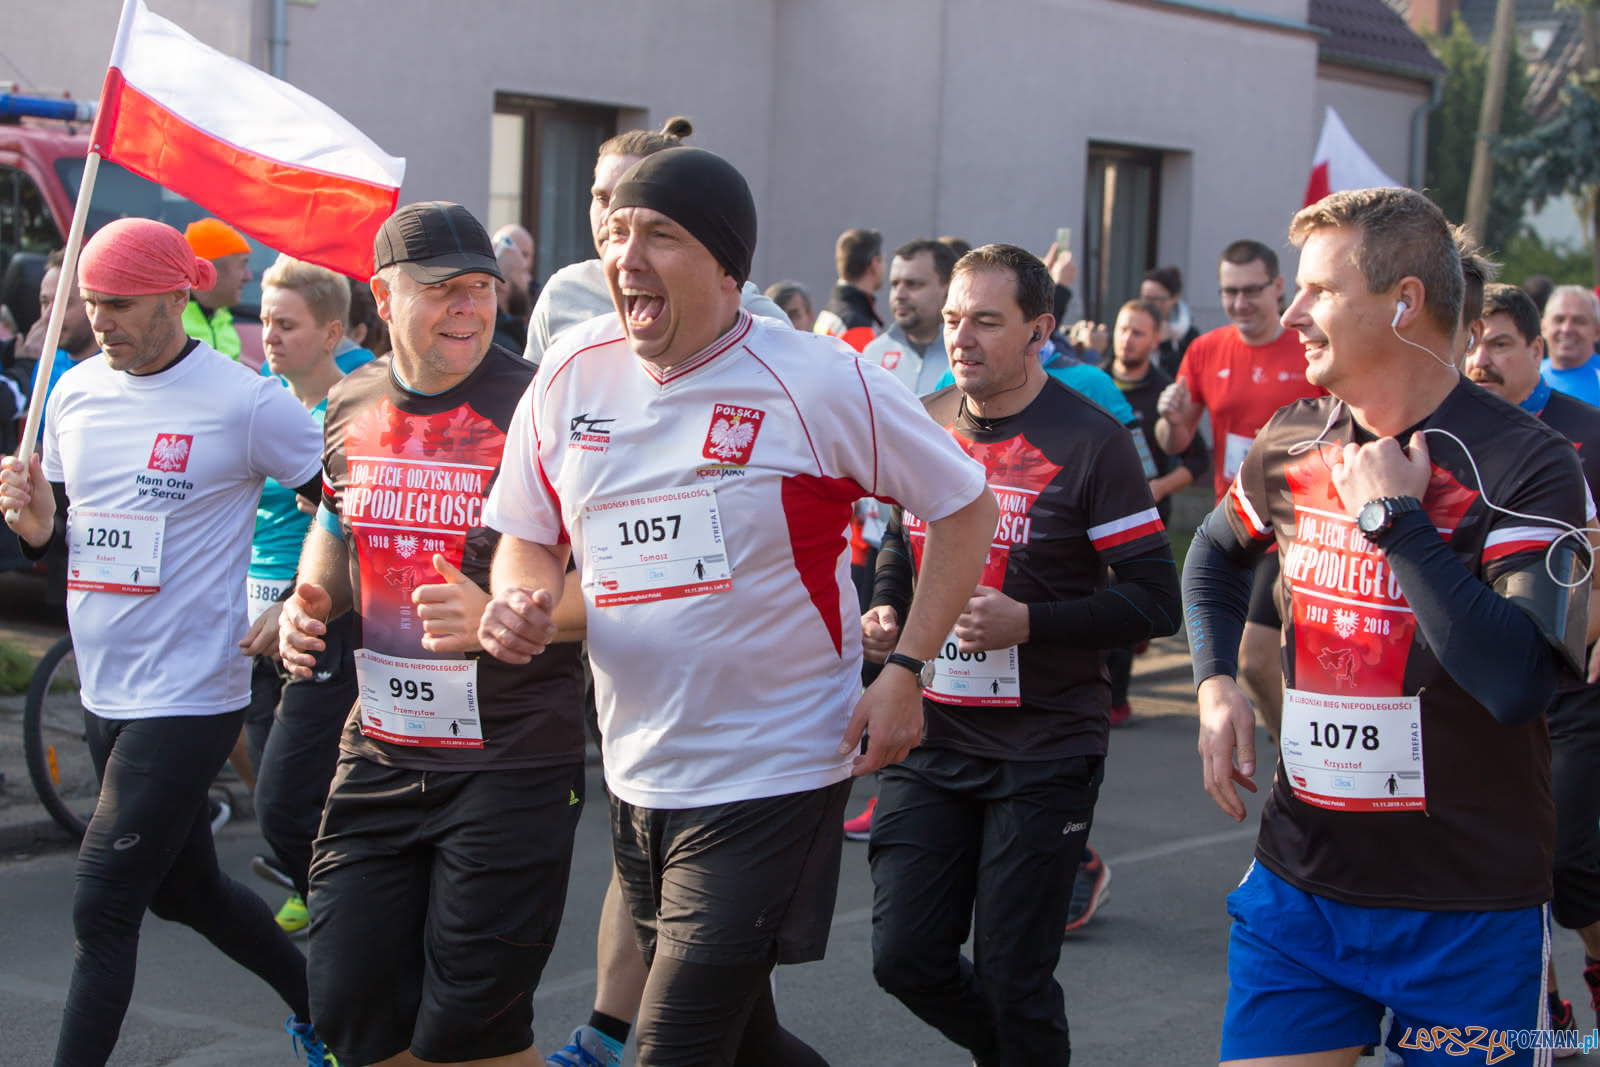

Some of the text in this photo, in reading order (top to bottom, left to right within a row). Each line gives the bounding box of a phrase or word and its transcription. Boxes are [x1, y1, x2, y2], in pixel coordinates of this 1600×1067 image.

[715, 405, 760, 420] POLSKA
[136, 475, 193, 490] Mam Orła
[351, 464, 482, 493] 100-LECIE ODZYSKANIA
[138, 487, 186, 500] w Sercu
[593, 501, 629, 512] LUBOŃSKI
[647, 489, 709, 504] NIEPODLEGŁOŚCI
[87, 528, 132, 549] 1201
[618, 514, 681, 546] 1057
[711, 515, 721, 543] STREFA
[1298, 516, 1348, 549] 100-LECIE
[368, 535, 389, 549] 1918
[423, 538, 446, 552] 2018
[640, 553, 668, 562] Tomasz
[1306, 605, 1328, 624] 1918
[1363, 616, 1390, 635] 2018
[367, 654, 394, 667] LUBOŃSKI
[395, 661, 409, 669] BIEG
[410, 663, 469, 672] NIEPODLEGŁOŚCI
[949, 668, 970, 676] Daniel
[389, 677, 434, 701] 995
[467, 688, 476, 712] STREFA
[1323, 701, 1340, 709] BIEG
[1341, 702, 1412, 710] NIEPODLEGŁOŚCI
[393, 705, 435, 717] Przemysław
[1310, 721, 1379, 751] 1078
[1411, 731, 1420, 760] STREFA
[1324, 759, 1362, 770] Krzysztof
